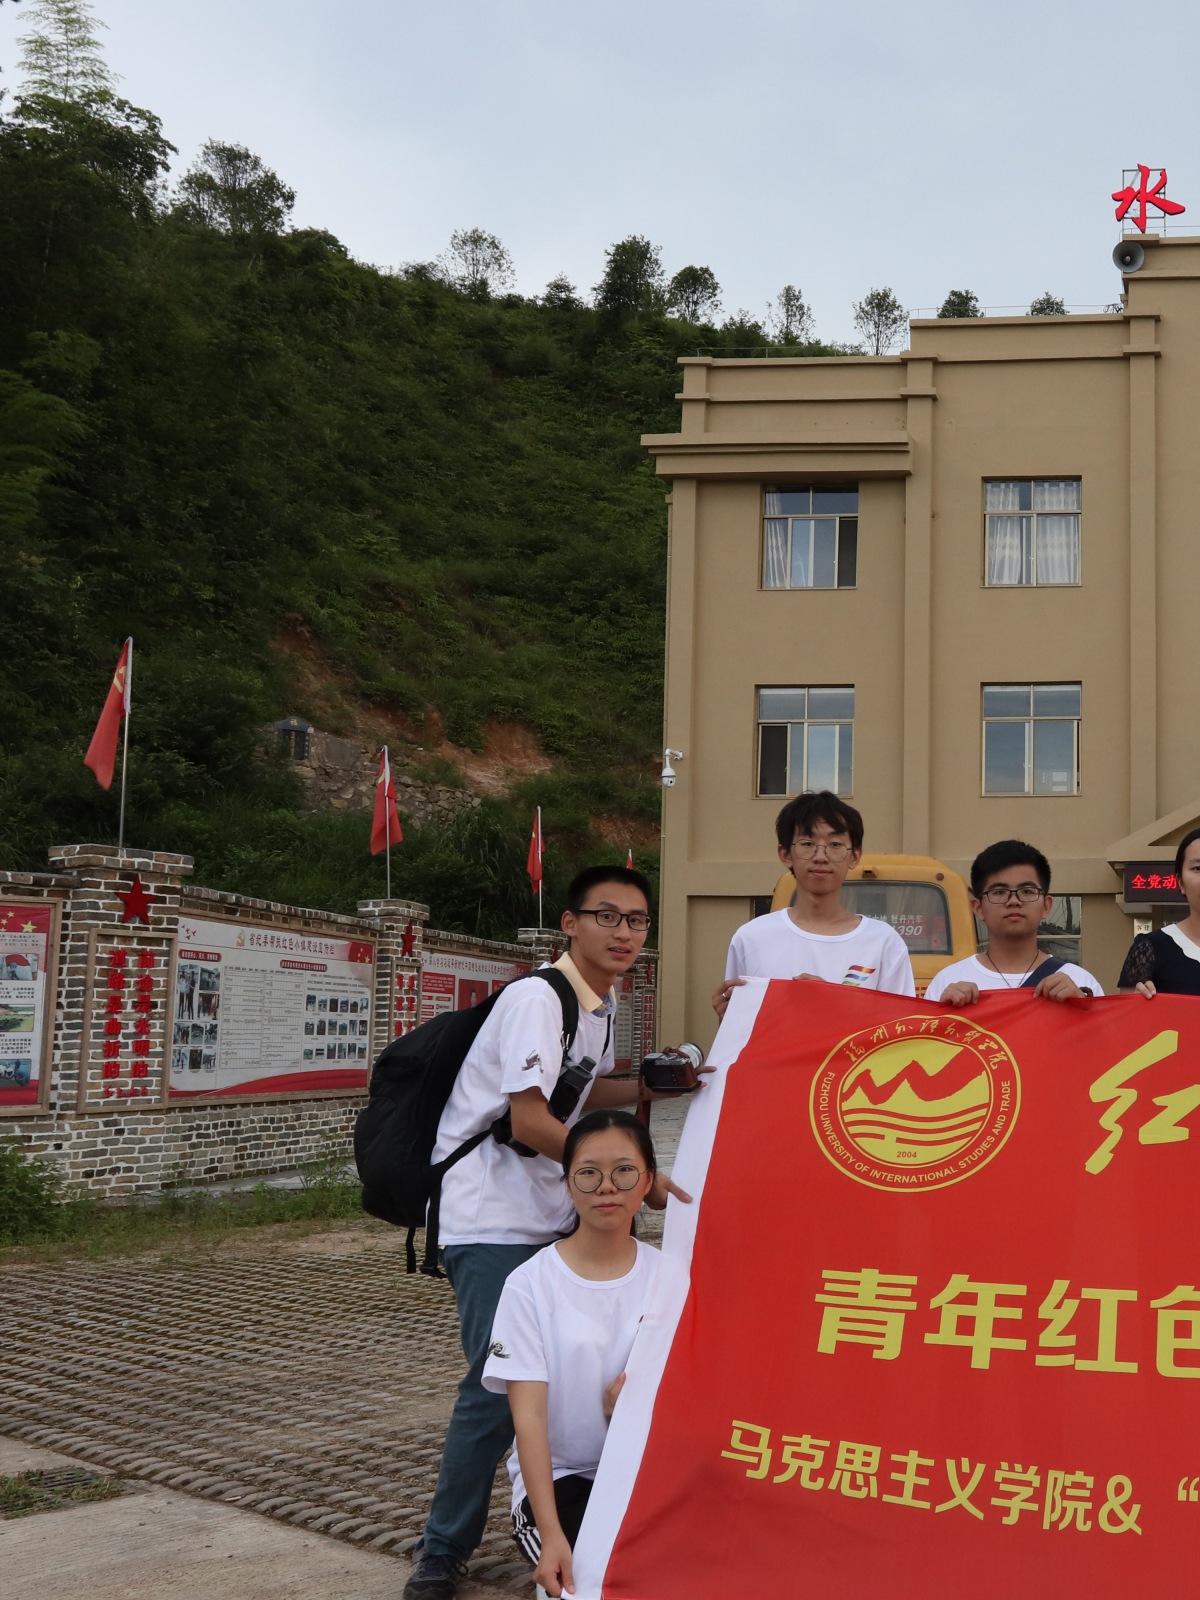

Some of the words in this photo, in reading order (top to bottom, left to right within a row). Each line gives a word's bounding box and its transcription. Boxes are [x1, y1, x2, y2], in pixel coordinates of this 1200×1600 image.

[890, 914, 923, 924] 牡丹汽车
[893, 925, 923, 936] 390
[102, 949, 127, 1079] 道路是曲折的
[819, 1071, 836, 1111] FUZHOU
[1000, 1080, 1011, 1113] TRADE
[820, 1113, 857, 1164] UNIVERSITY
[992, 1114, 1006, 1136] AND
[854, 1162, 870, 1173] OF
[958, 1135, 995, 1169] STUDIES
[869, 1166, 959, 1183] INTERNATIONAL
[720, 1419, 1143, 1536] 马克思主义学院&
